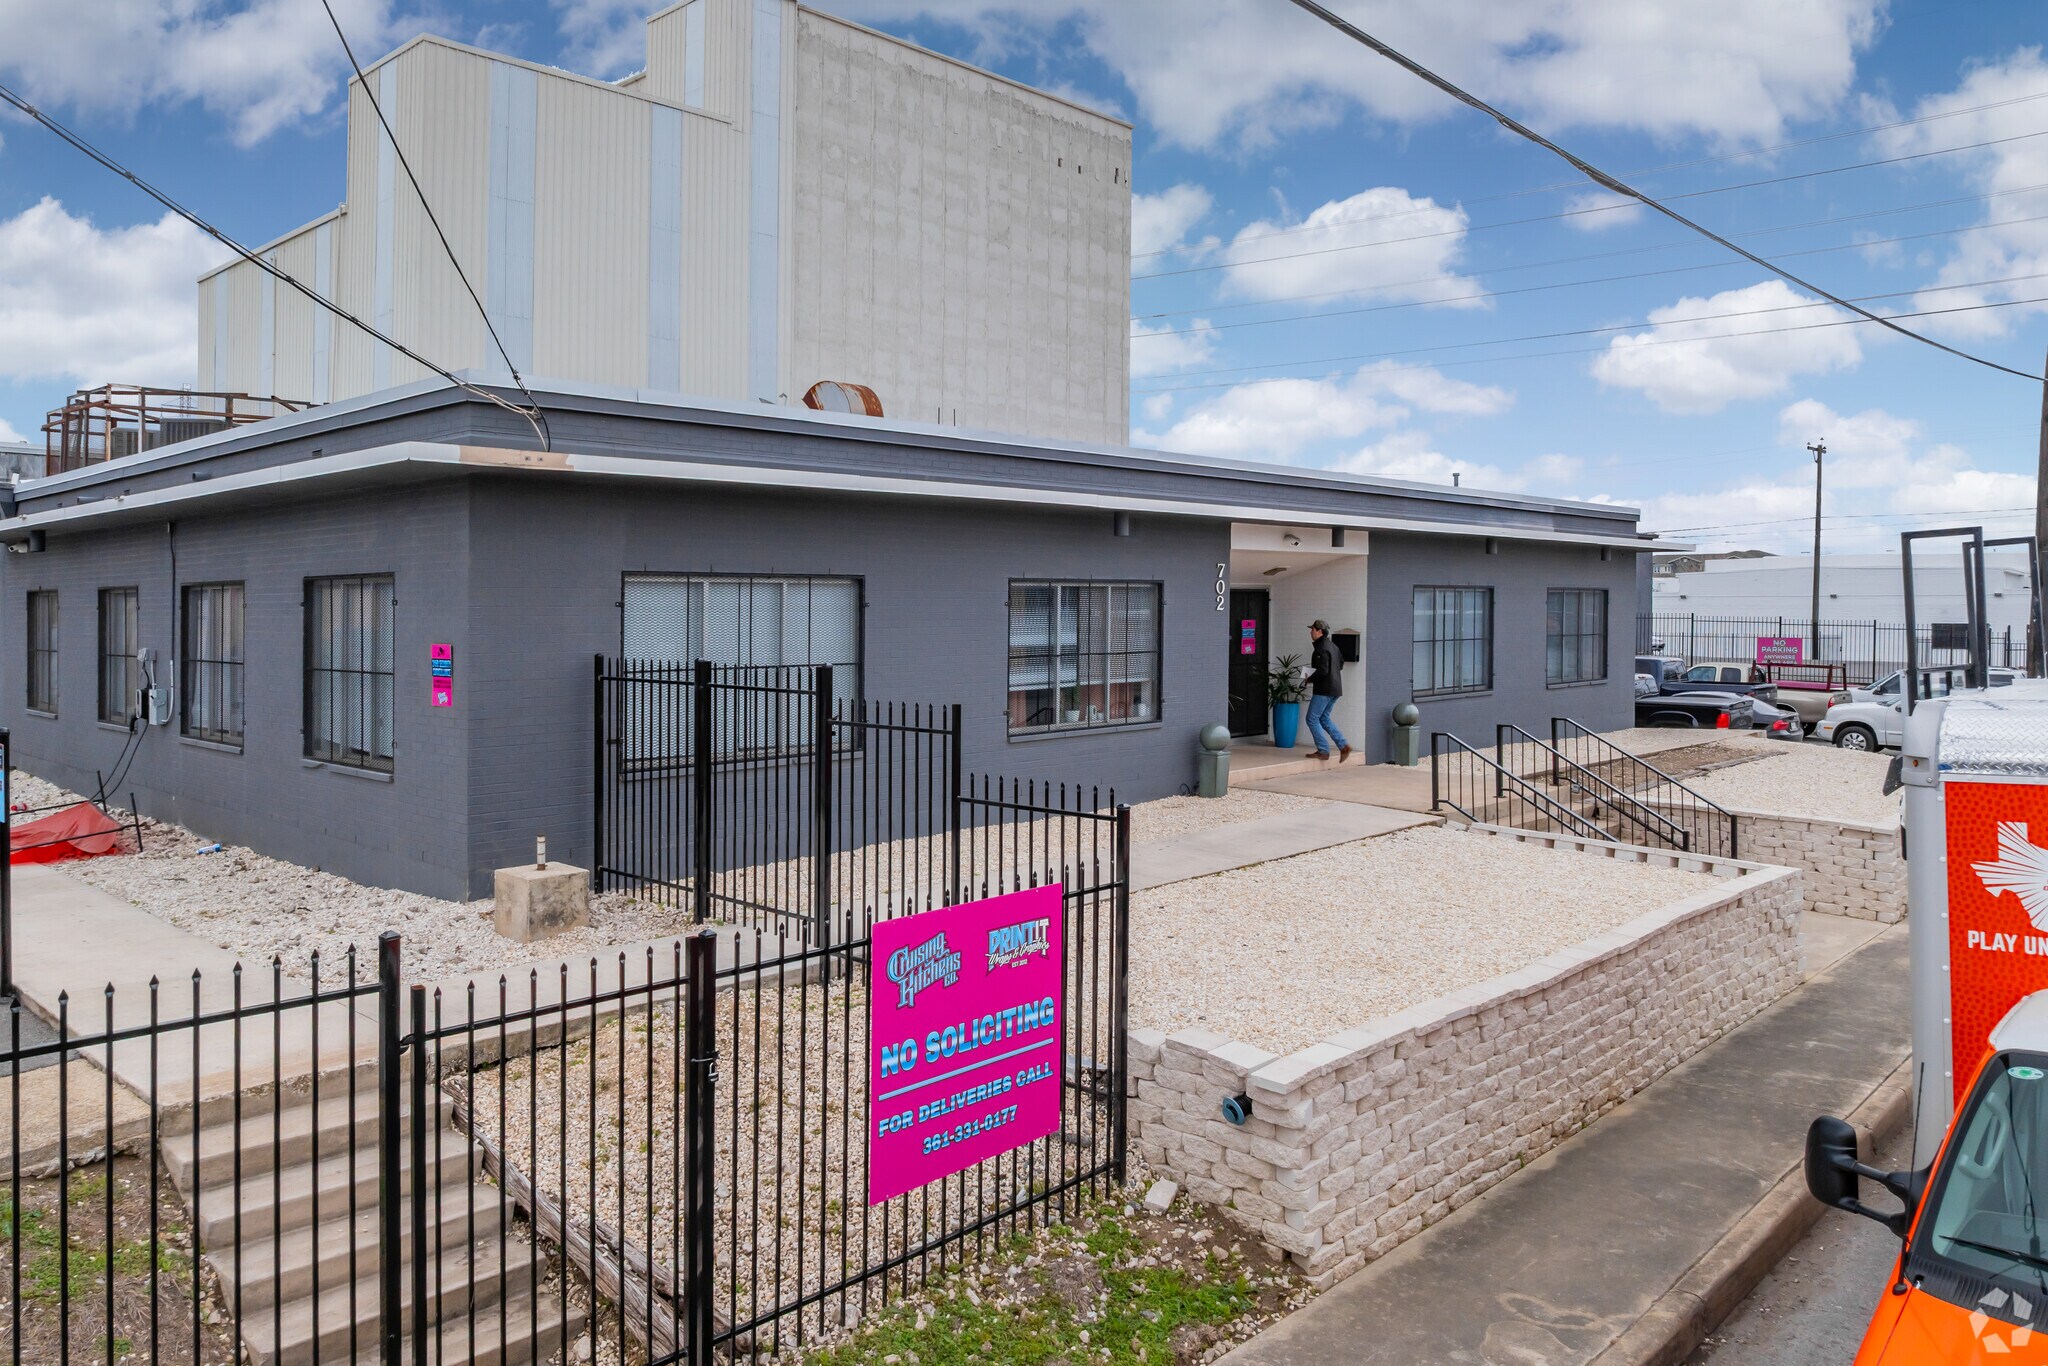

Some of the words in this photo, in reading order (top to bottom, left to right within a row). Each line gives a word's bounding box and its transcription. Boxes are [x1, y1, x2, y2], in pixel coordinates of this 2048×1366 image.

[1216, 563, 1226, 611] 702
[1967, 930, 2018, 953] PLAY
[881, 1038, 918, 1079] NO
[925, 996, 1055, 1063] SOLICITING
[878, 1110, 914, 1138] FOR
[918, 1075, 1012, 1123] DELIVERIES
[1015, 1061, 1054, 1087] CALL
[922, 1104, 1018, 1155] 361-331-0177
